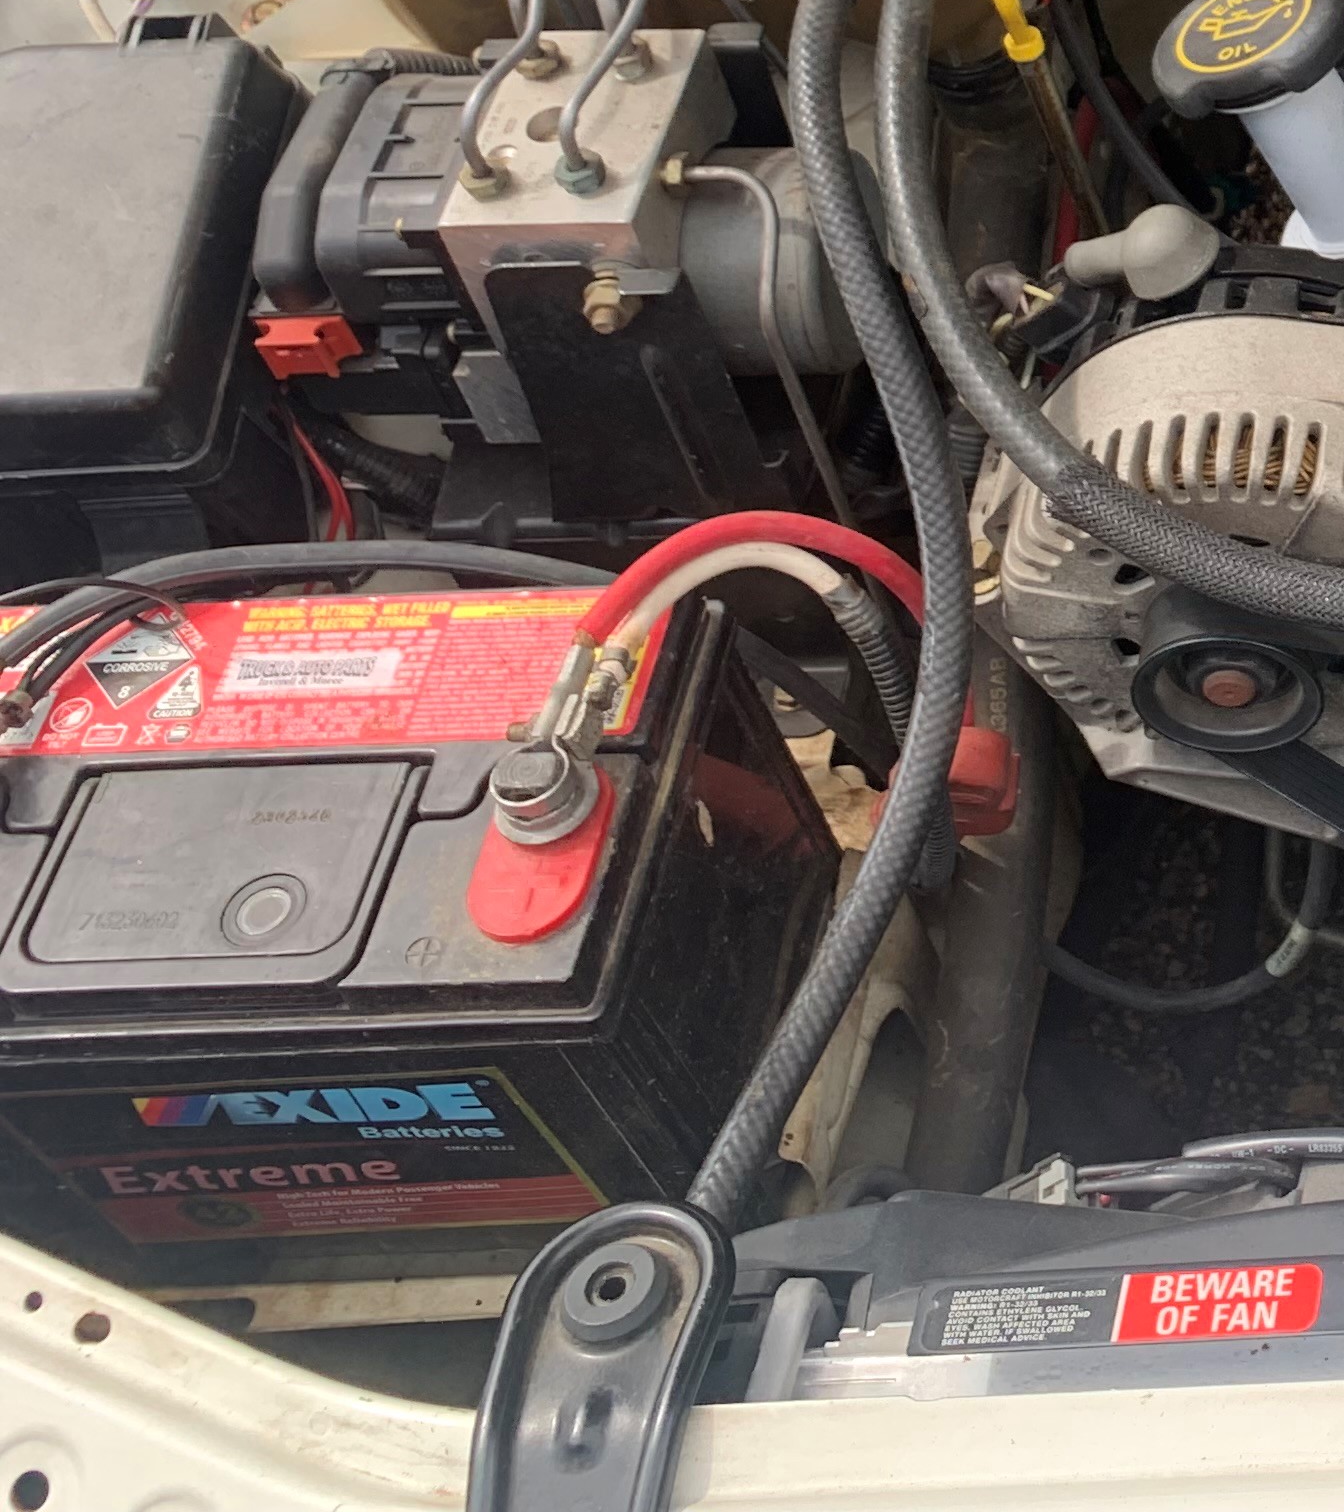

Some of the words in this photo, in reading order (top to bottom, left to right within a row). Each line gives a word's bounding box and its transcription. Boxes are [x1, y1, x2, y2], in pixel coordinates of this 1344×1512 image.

[1217, 42, 1257, 61] OIL
[169, 611, 208, 651] U2794
[103, 661, 170, 673] CORROSIVE
[117, 685, 132, 699] 8
[152, 709, 193, 718] CAUTION
[206, 1082, 497, 1126] EXIDE
[357, 1124, 506, 1140] Batteries
[99, 1159, 401, 1195] Extreme
[953, 1289, 999, 1298] RADIATOR
[1000, 1286, 1045, 1295] COOLANT
[1151, 1267, 1296, 1304] BEWARE
[951, 1297, 968, 1305] USE
[969, 1294, 1027, 1304] MOTORCRAFT
[946, 1317, 975, 1325] AVOID
[976, 1314, 1019, 1323] CONTACT
[1021, 1312, 1045, 1321] WITH
[1047, 1311, 1069, 1319] SKIN
[1071, 1310, 1091, 1318] AND
[948, 1309, 995, 1318] CONTAINS
[996, 1306, 1043, 1315] ETHYLENE
[1156, 1305, 1200, 1336] OF
[1211, 1300, 1279, 1333] FAN
[973, 1322, 999, 1331] WASH
[1002, 1320, 1049, 1329] AFFECTED
[1051, 1318, 1076, 1326] AREA
[943, 1331, 967, 1339] WITH
[1016, 1325, 1074, 1335] SWALLOWED
[941, 1338, 965, 1347] SEEK
[967, 1335, 1009, 1345] MEDICAL
